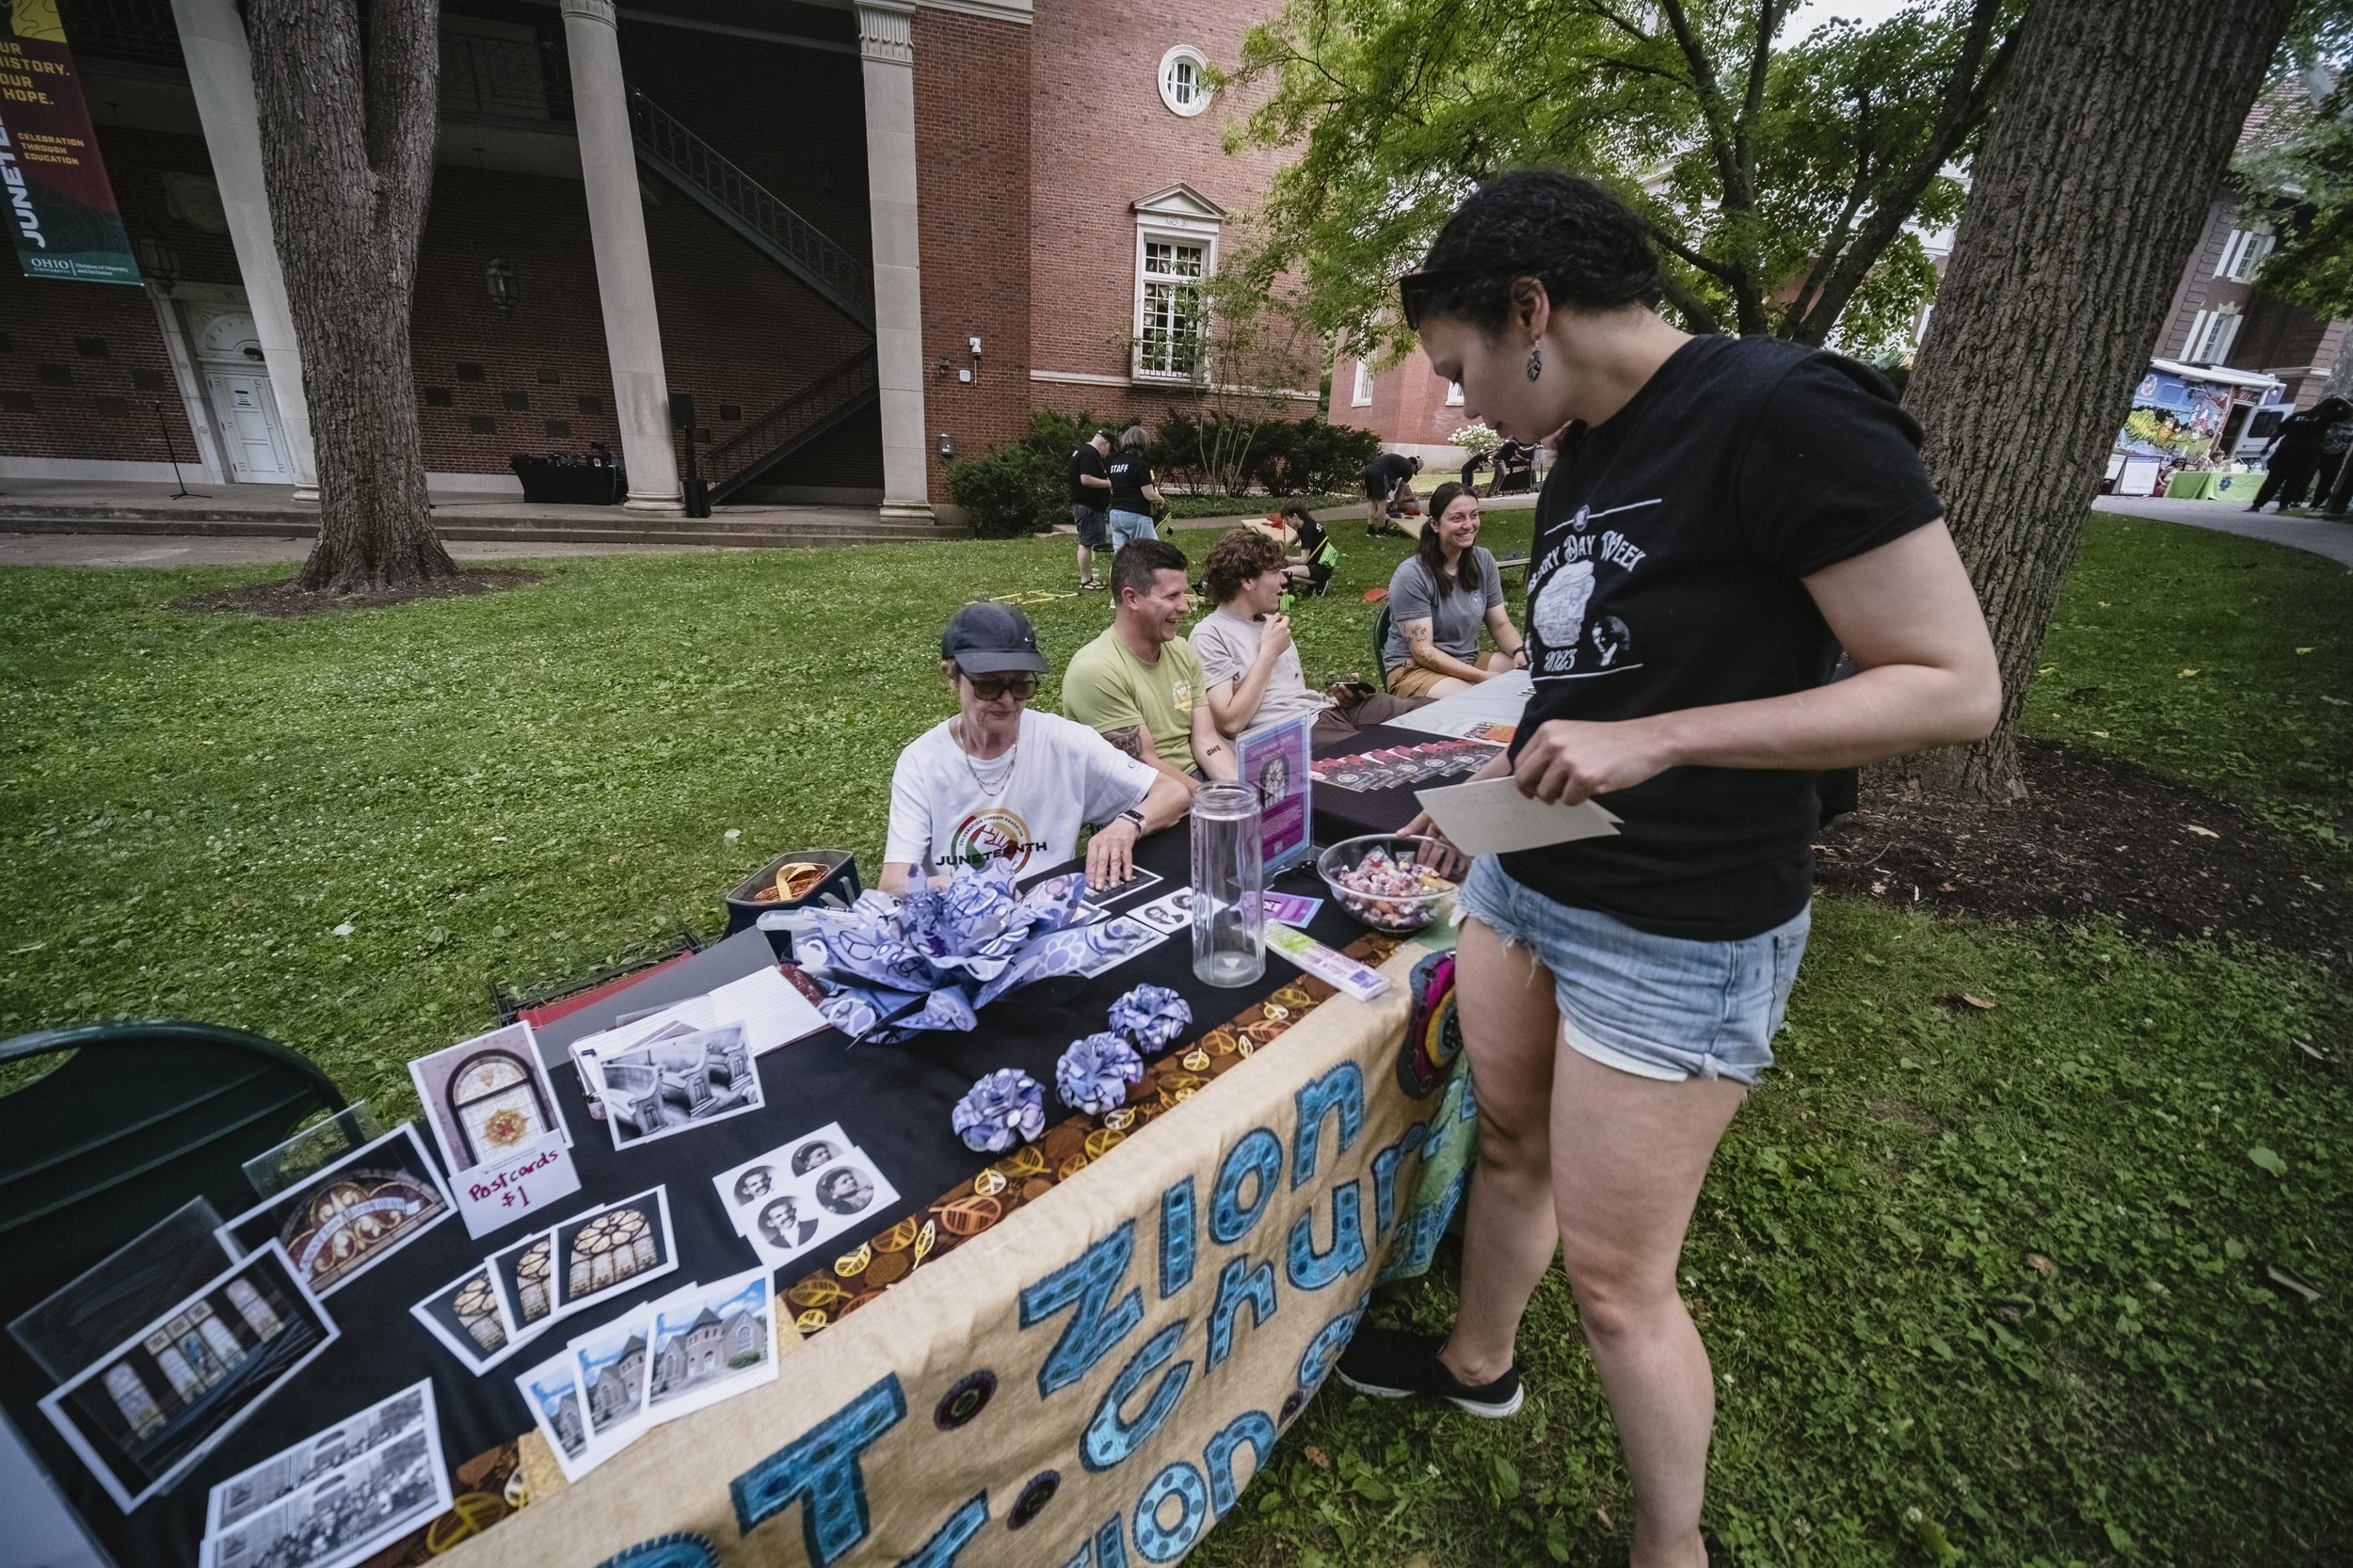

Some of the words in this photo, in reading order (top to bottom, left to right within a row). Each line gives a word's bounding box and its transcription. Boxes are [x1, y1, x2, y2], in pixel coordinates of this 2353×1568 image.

[0, 42, 22, 55] UR
[0, 73, 33, 88] OUR
[3, 88, 55, 105] HOPE.
[17, 132, 85, 148] CELEBRATION
[21, 142, 68, 154] THROUGH
[24, 152, 80, 165] EDUCATION
[0, 116, 46, 248] JUNETE
[31, 257, 70, 269] OHIO
[1111, 464, 1128, 473] STAFF
[1544, 648, 1578, 672] 2023
[468, 1149, 559, 1203] Postcards
[502, 1186, 530, 1208] $1
